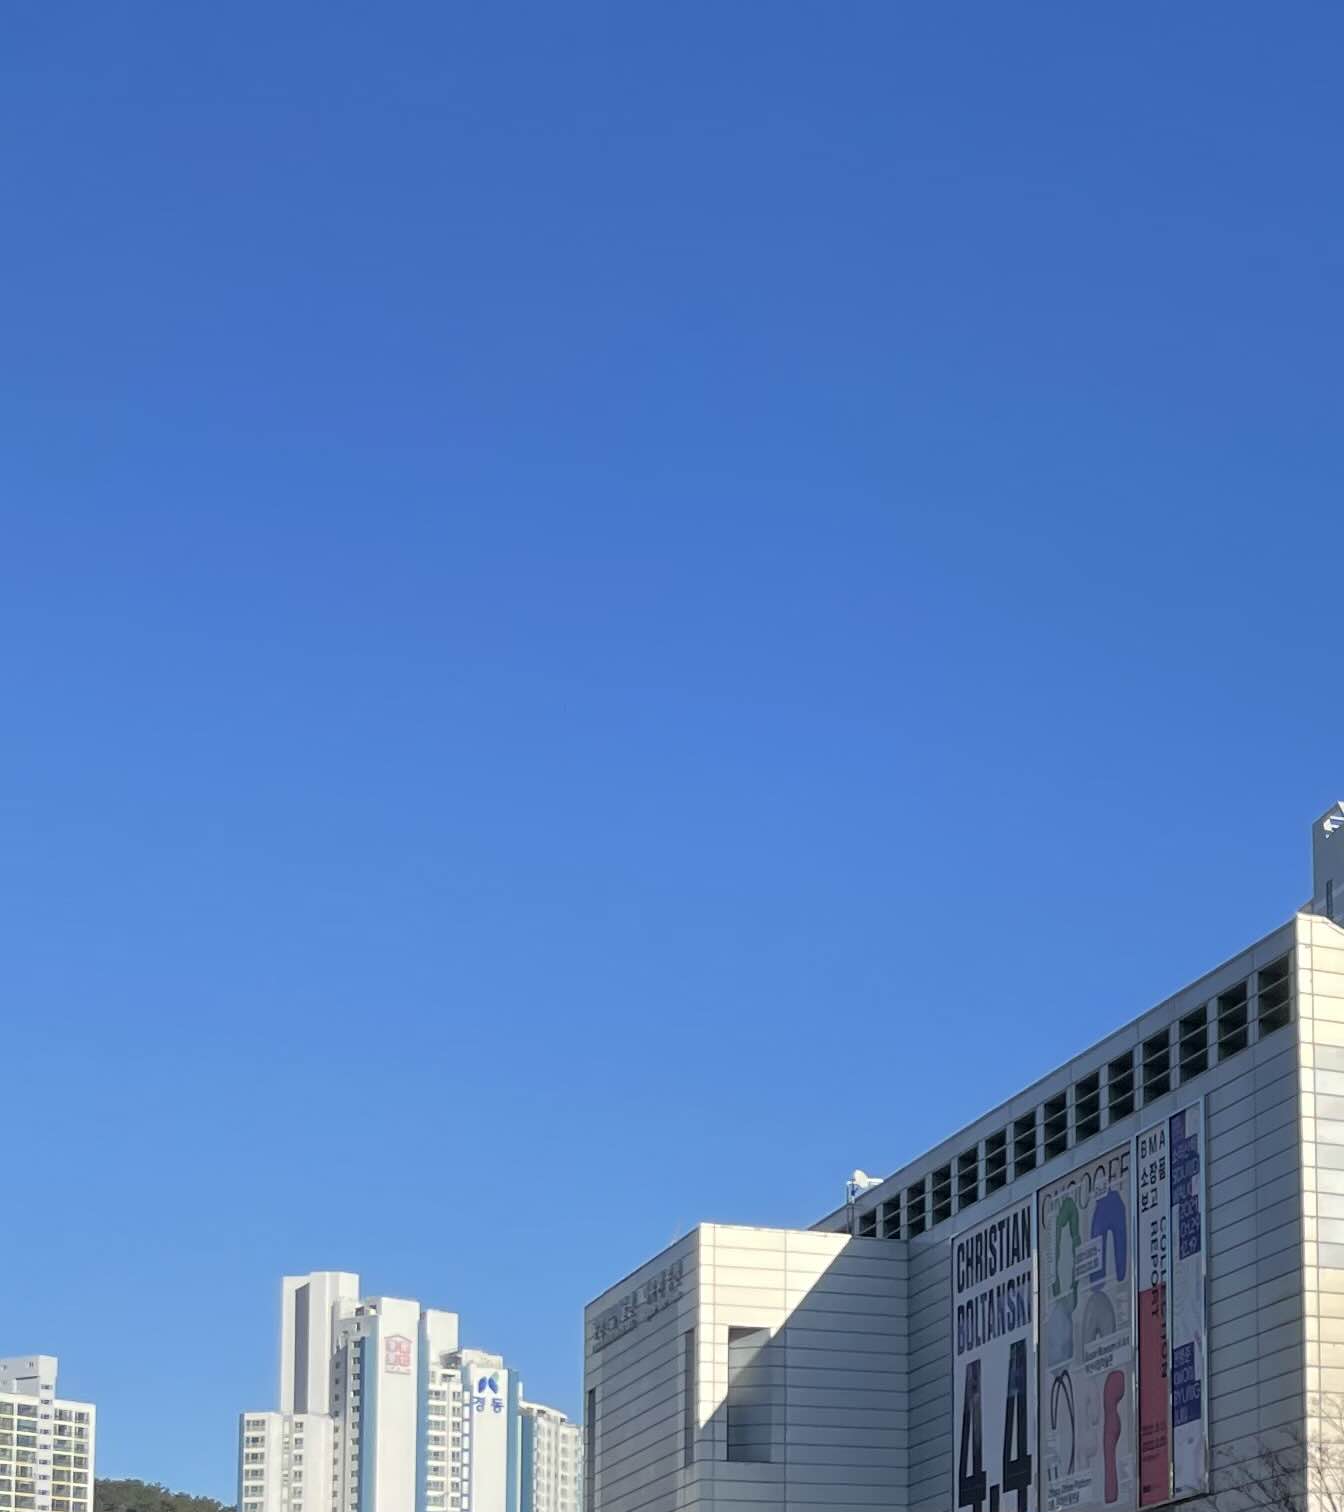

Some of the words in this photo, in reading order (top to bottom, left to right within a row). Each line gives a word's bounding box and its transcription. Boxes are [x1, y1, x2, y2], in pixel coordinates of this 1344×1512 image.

[1140, 1129, 1166, 1159] BMA
[1140, 1156, 1166, 1188] 소장품
[1141, 1188, 1158, 1213] 보고
[957, 1205, 1032, 1294] CHRISTIAN
[1150, 1221, 1160, 1318] REPORT
[957, 1271, 1033, 1356] BOLTANSKI
[472, 1396, 505, 1414] 경동
